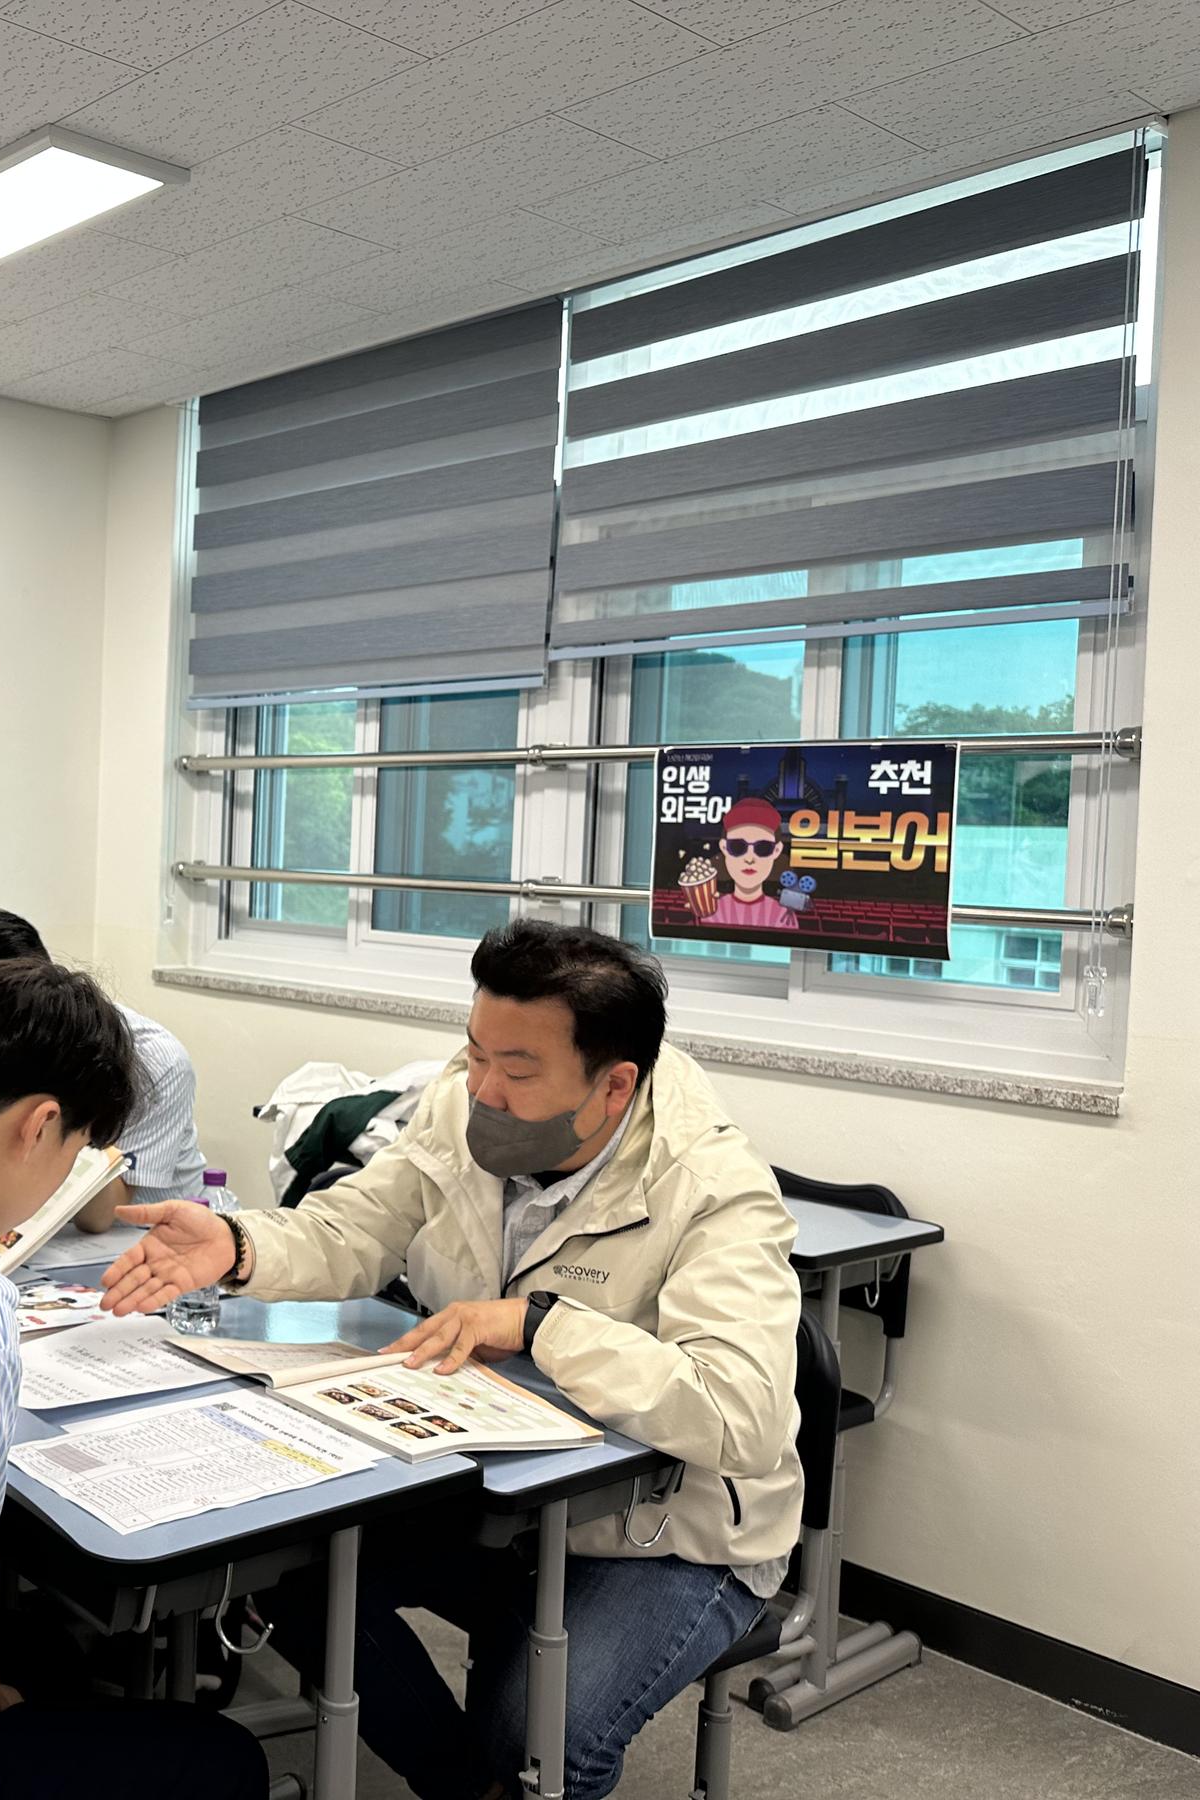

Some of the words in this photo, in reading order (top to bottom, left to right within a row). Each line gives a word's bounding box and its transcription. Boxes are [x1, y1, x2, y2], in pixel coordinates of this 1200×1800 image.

[662, 765, 711, 794] 인생
[868, 760, 932, 795] 추천
[660, 796, 732, 824] 외국어
[788, 809, 950, 873] 일본어
